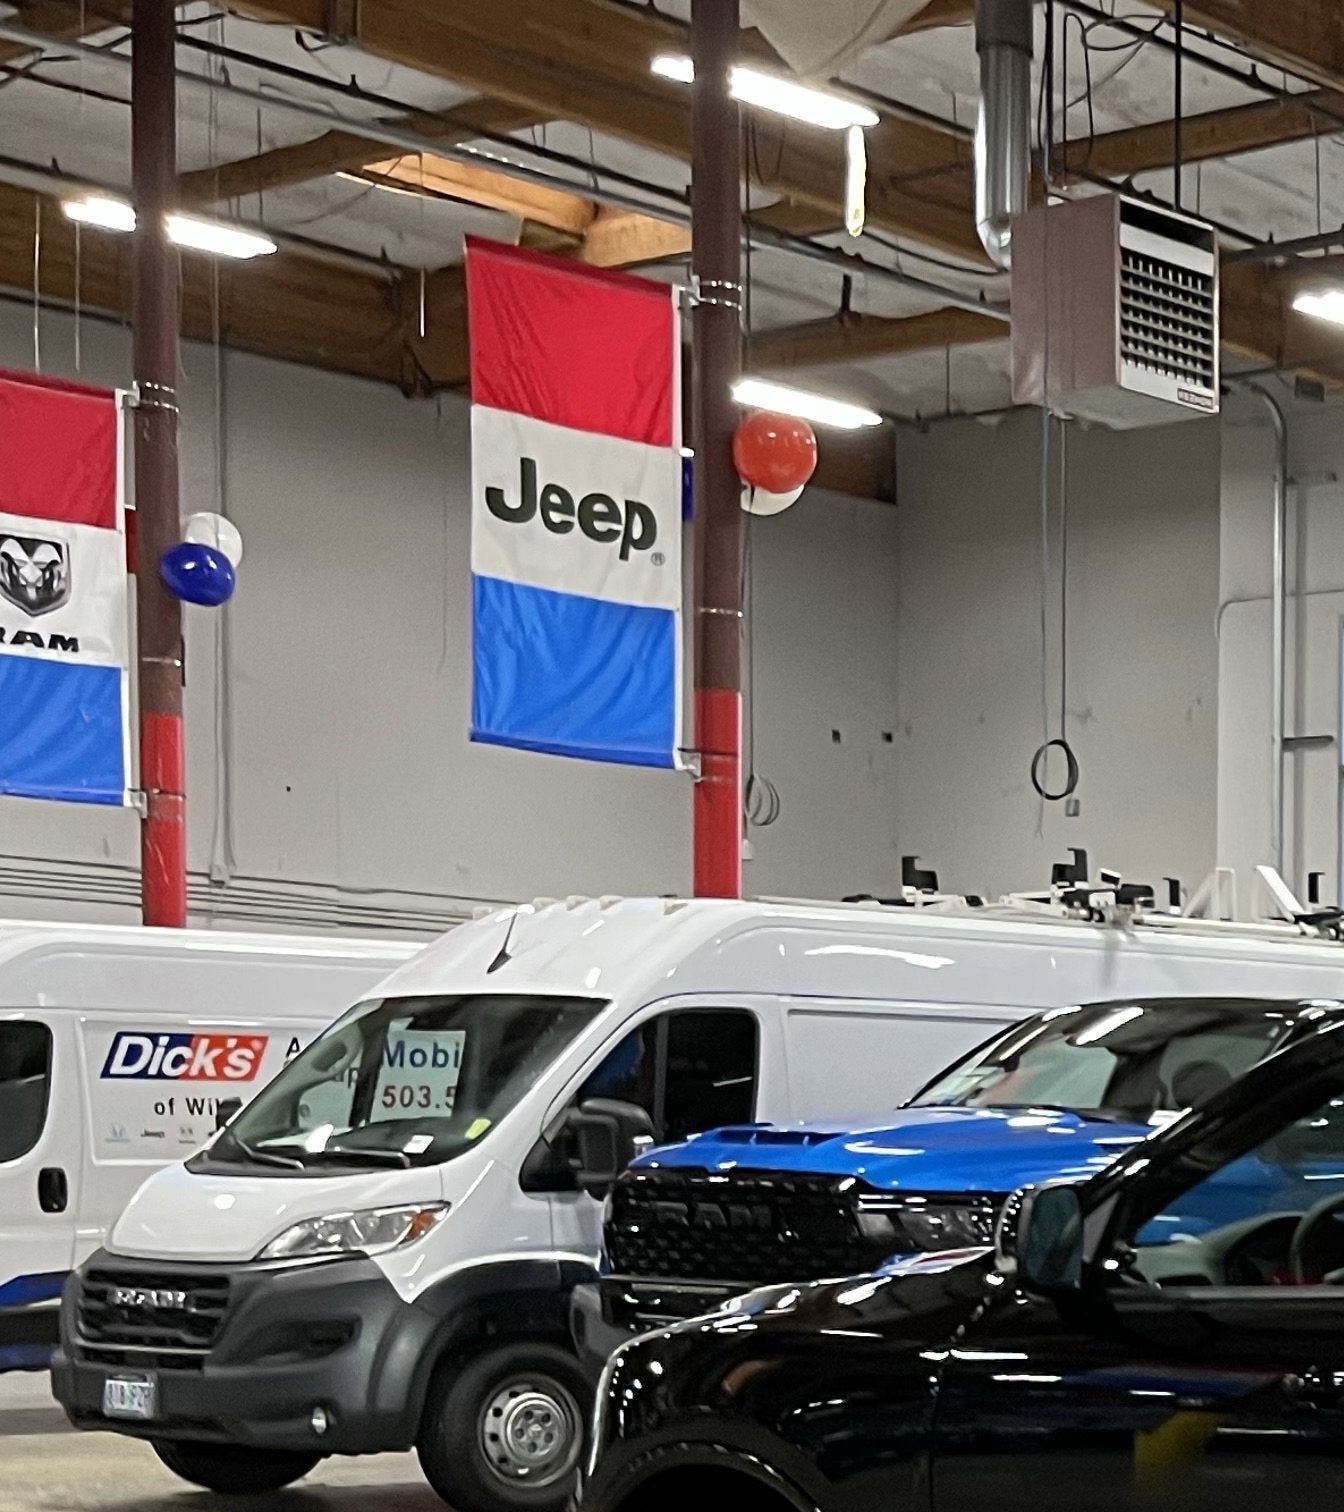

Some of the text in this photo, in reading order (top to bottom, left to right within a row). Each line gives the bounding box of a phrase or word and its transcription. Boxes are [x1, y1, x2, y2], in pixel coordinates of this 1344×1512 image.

[485, 457, 657, 562] Jeep
[0, 627, 79, 653] AM
[109, 1035, 255, 1078] Dick's
[154, 1097, 175, 1116] of
